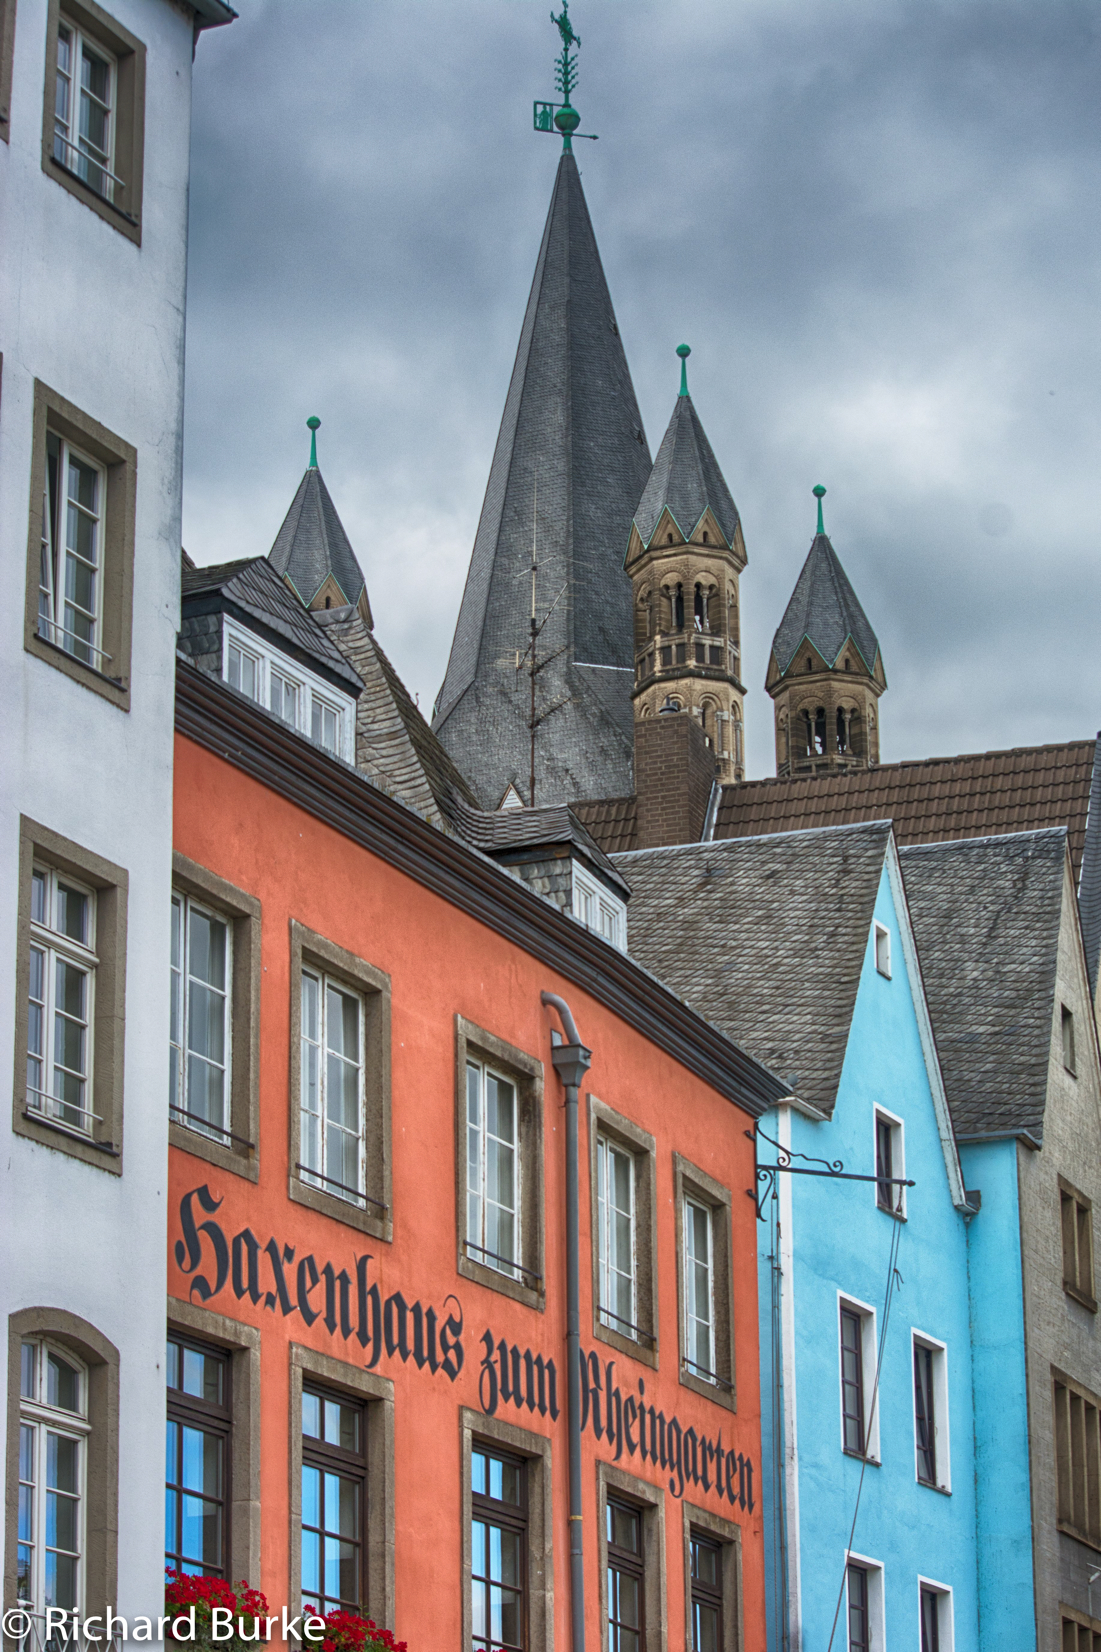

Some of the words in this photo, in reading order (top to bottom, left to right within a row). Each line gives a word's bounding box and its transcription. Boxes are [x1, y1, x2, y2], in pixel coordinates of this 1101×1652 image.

[174, 1184, 464, 1382] Haxenhaus
[480, 1329, 560, 1422] zum
[580, 1348, 755, 1514] Rheingarten
